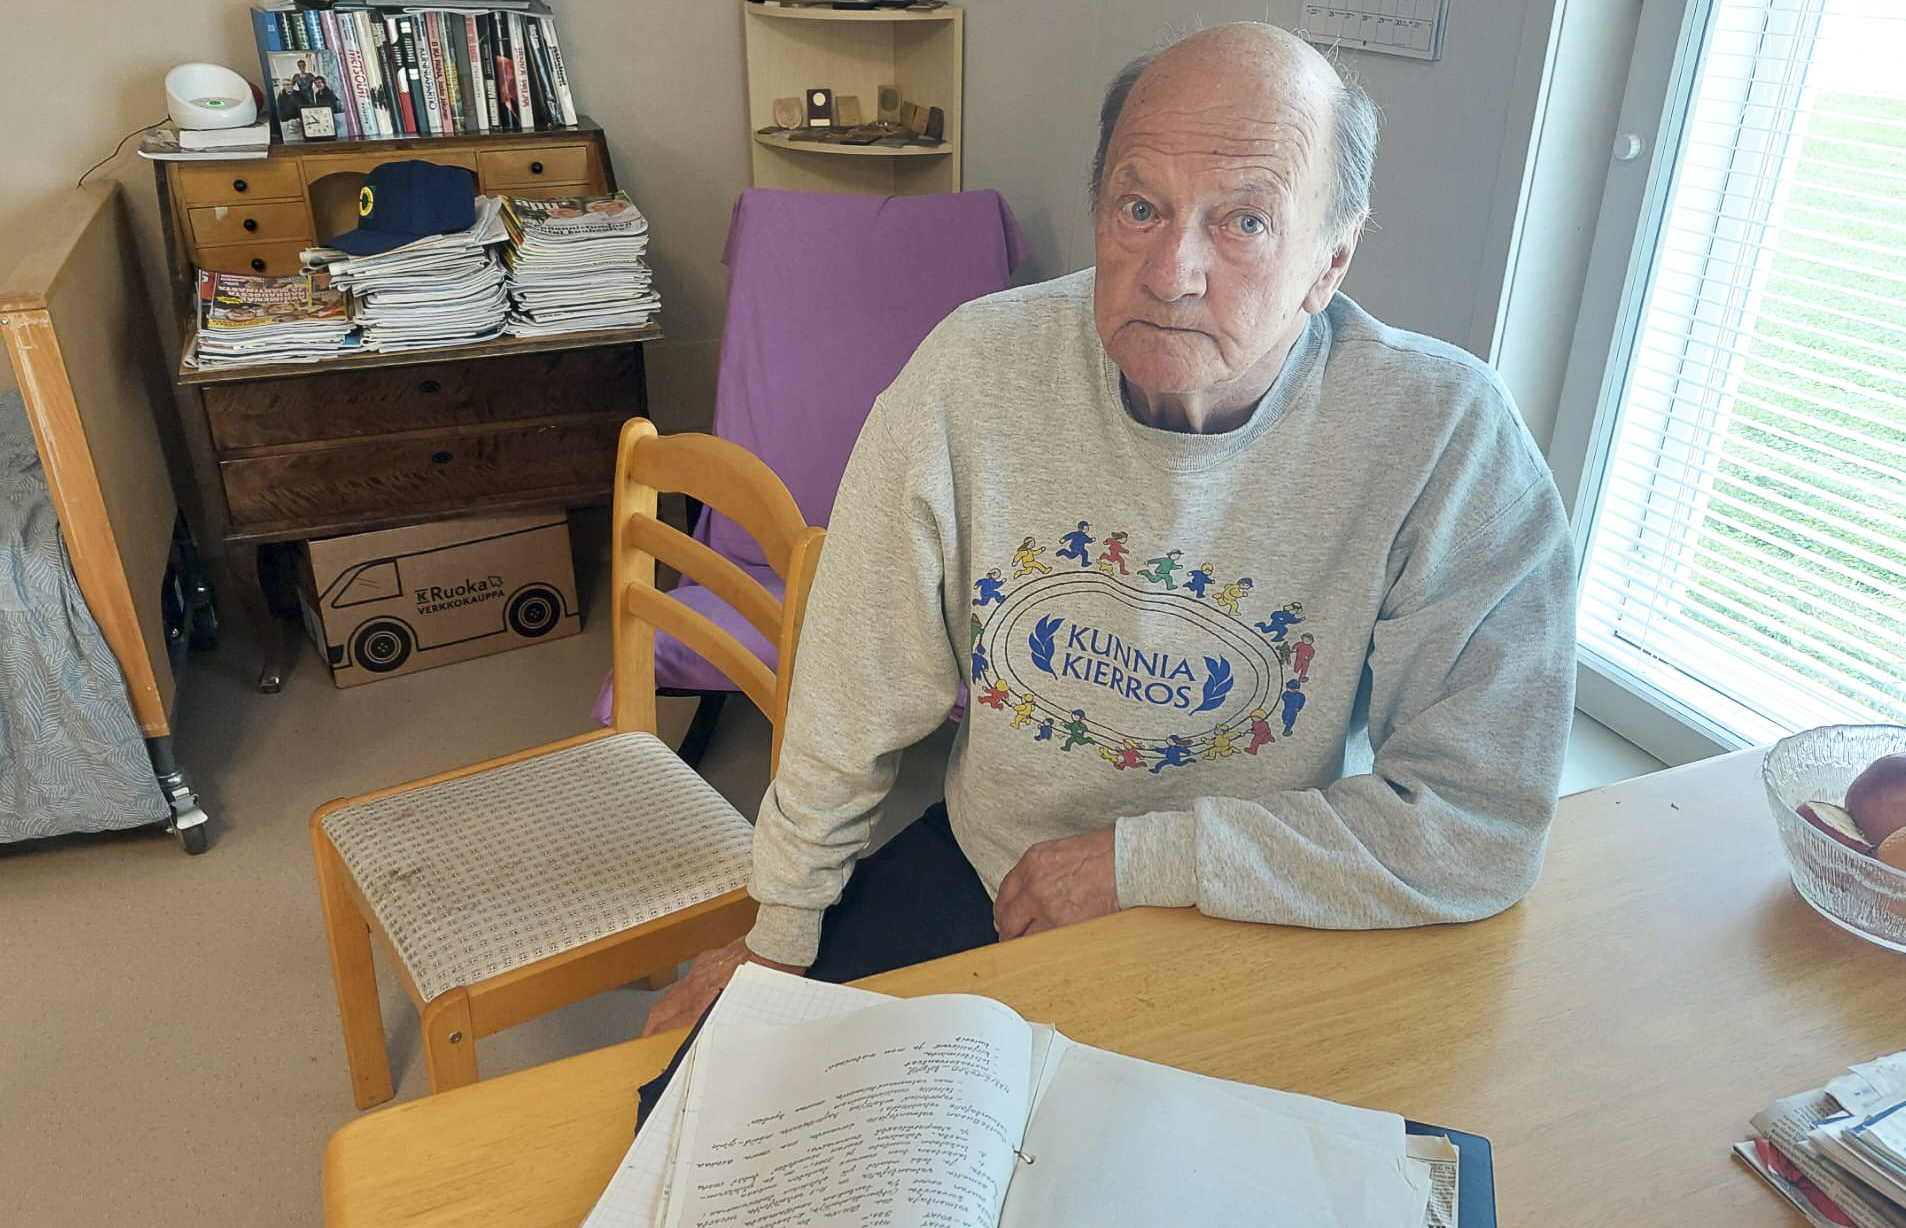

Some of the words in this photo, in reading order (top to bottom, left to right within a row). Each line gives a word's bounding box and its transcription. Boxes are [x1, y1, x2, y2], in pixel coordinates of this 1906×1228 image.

[348, 49, 370, 98] METSOLAT
[417, 589, 505, 615] VERKKOKAUPPA
[430, 578, 488, 602] Ruoka
[1067, 624, 1196, 682] KUNNIA
[1061, 652, 1192, 709] KIERROS
